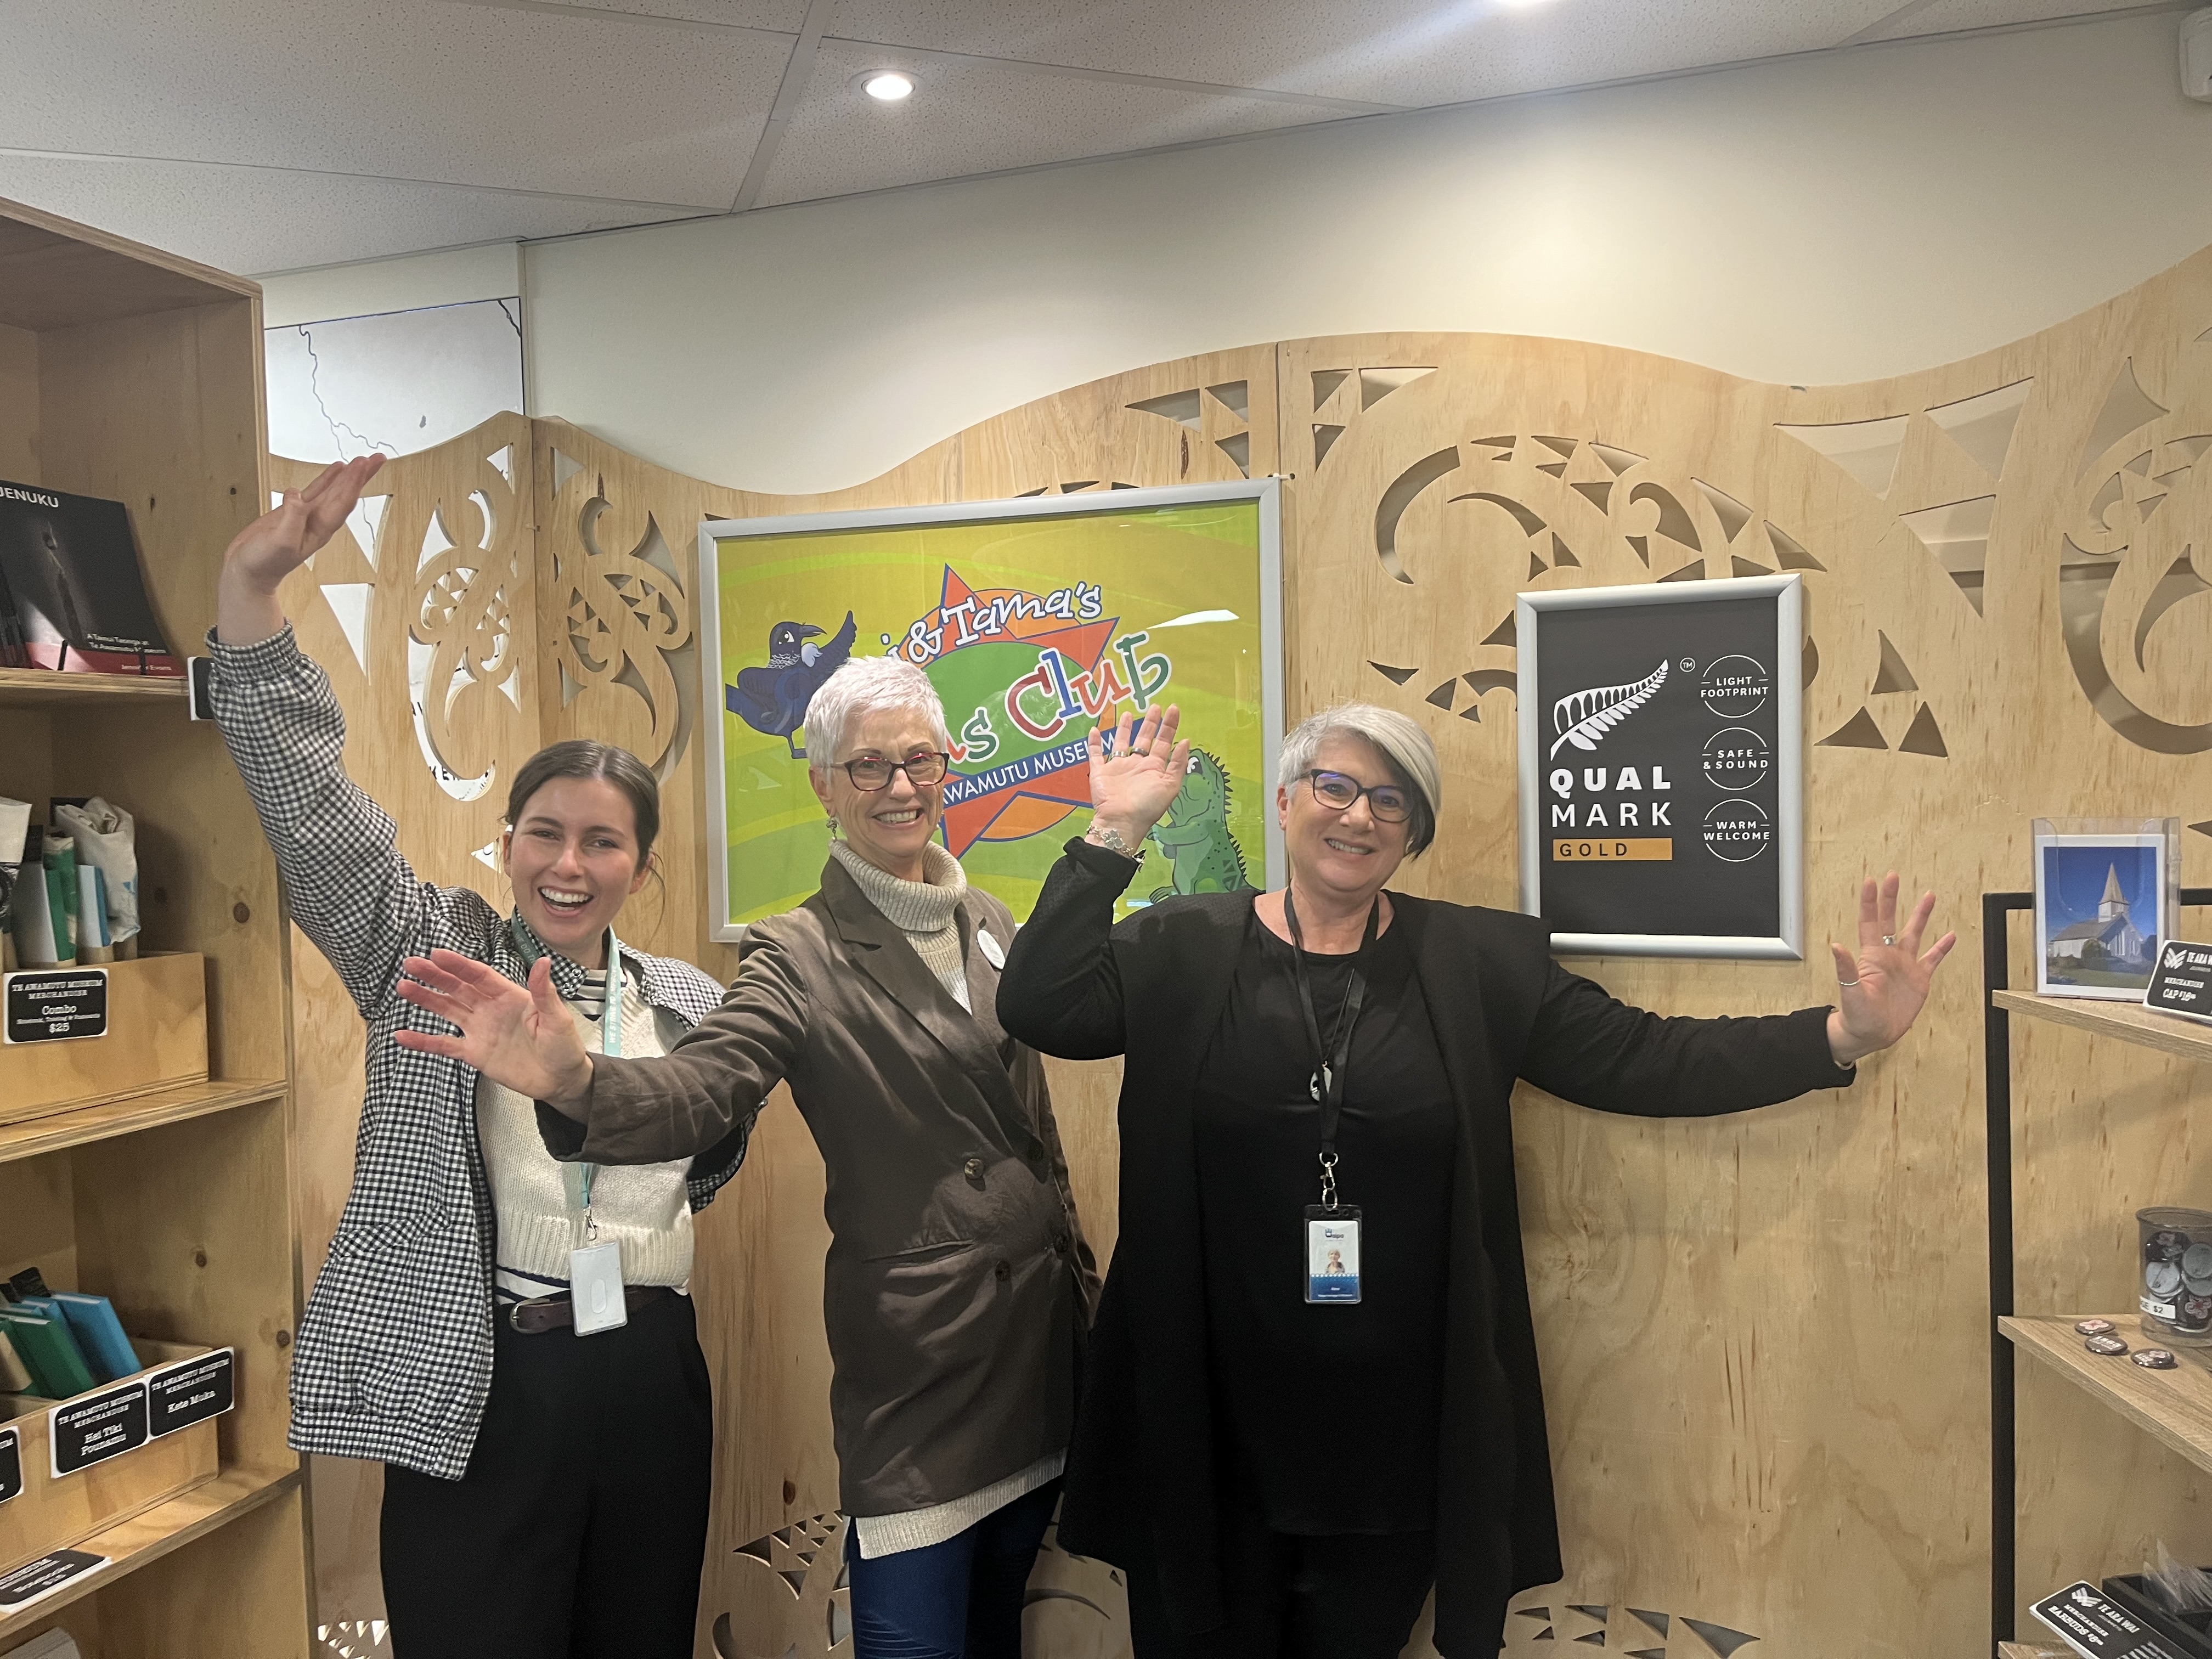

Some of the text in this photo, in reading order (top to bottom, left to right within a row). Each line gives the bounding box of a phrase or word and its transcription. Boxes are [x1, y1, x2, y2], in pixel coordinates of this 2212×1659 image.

[908, 620, 943, 663] &
[941, 582, 1101, 646] Tama's
[1006, 633, 1170, 740] Club
[1716, 676, 1752, 686] LIGHT
[1701, 686, 1769, 698] FOOTPRINT
[1717, 749, 1753, 758] SAFE
[1702, 760, 1769, 770] & SOUND
[943, 761, 1029, 805] WAMUTU
[1549, 765, 1671, 799] QUAL
[1551, 802, 1672, 827] MARK
[1716, 821, 1757, 830] WARM
[1703, 832, 1770, 841] WELCOME
[1559, 842, 1628, 857] GOLD
